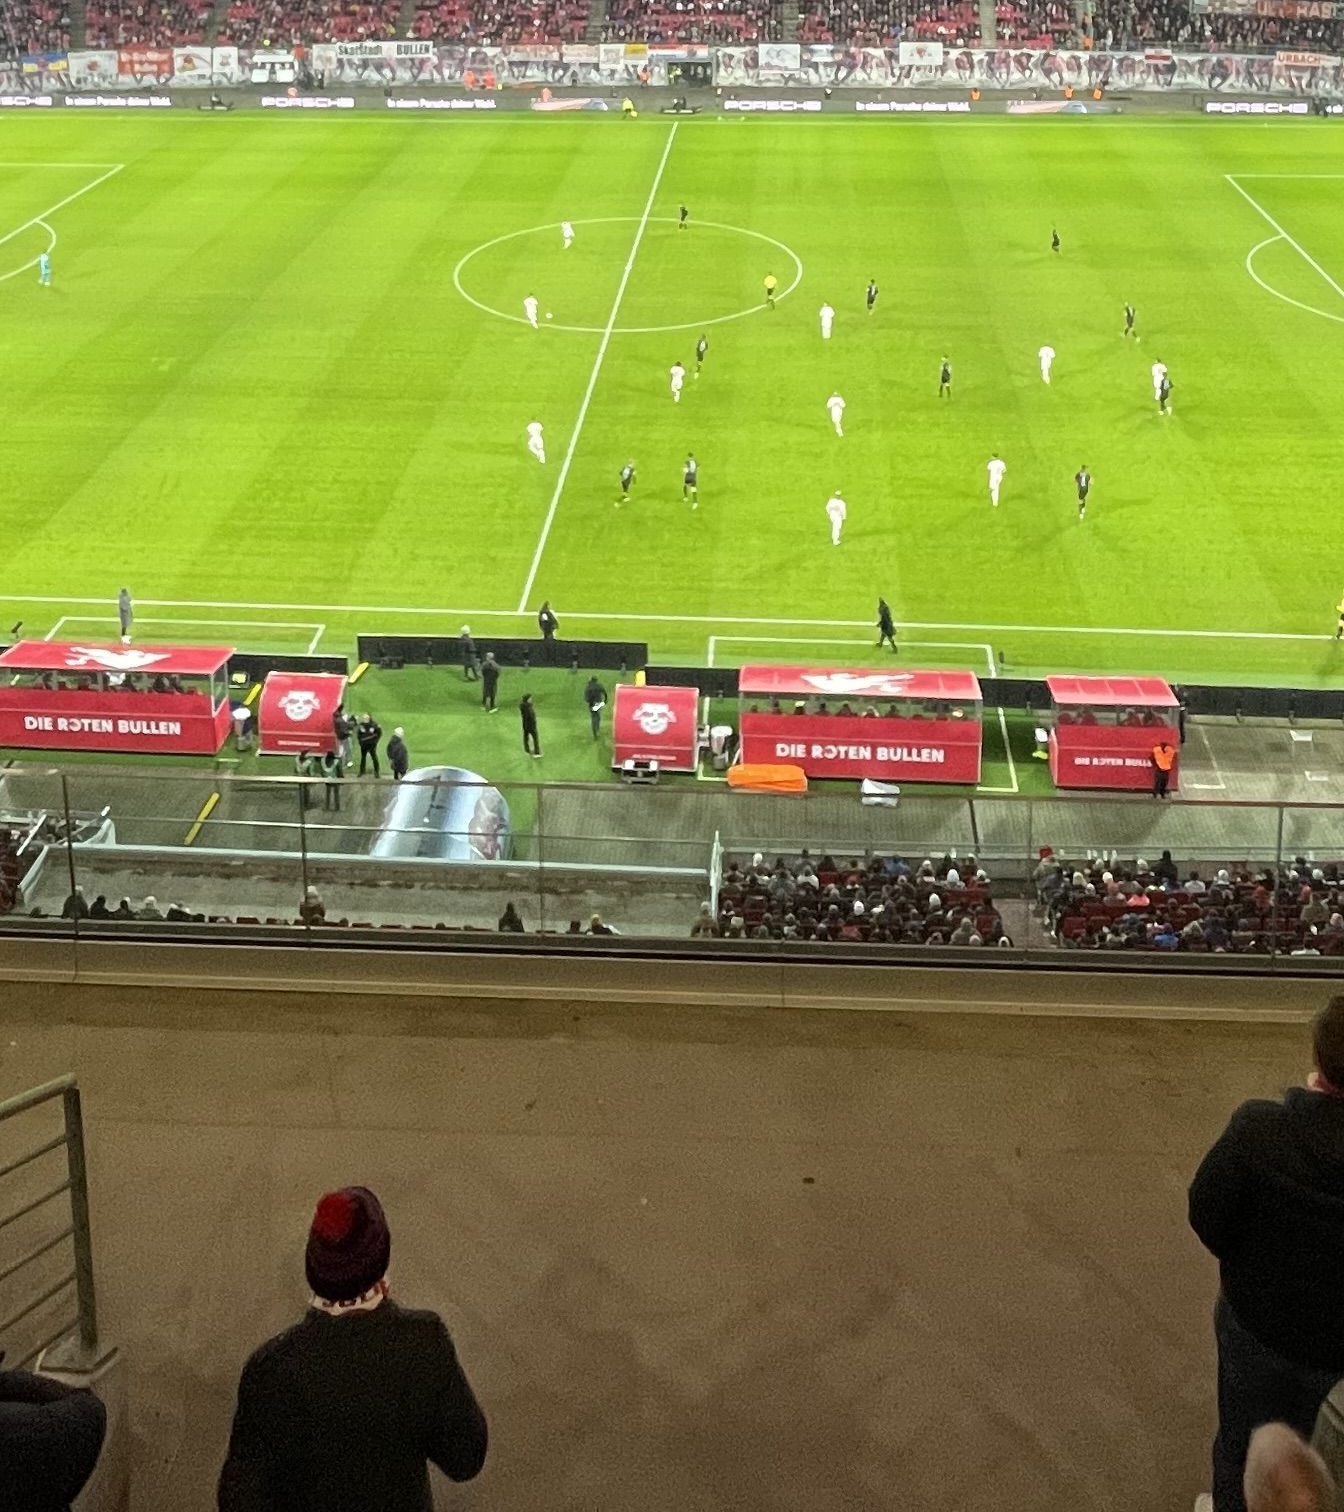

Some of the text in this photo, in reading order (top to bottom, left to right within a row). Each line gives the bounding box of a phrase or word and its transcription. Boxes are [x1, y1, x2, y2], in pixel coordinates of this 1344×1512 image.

[724, 100, 822, 111] PORSCHE
[1206, 102, 1308, 114] PORSCHE
[24, 716, 53, 731] DIE
[118, 720, 181, 735] BULLEN
[776, 743, 806, 757] DIE
[876, 747, 945, 763] BULLEN
